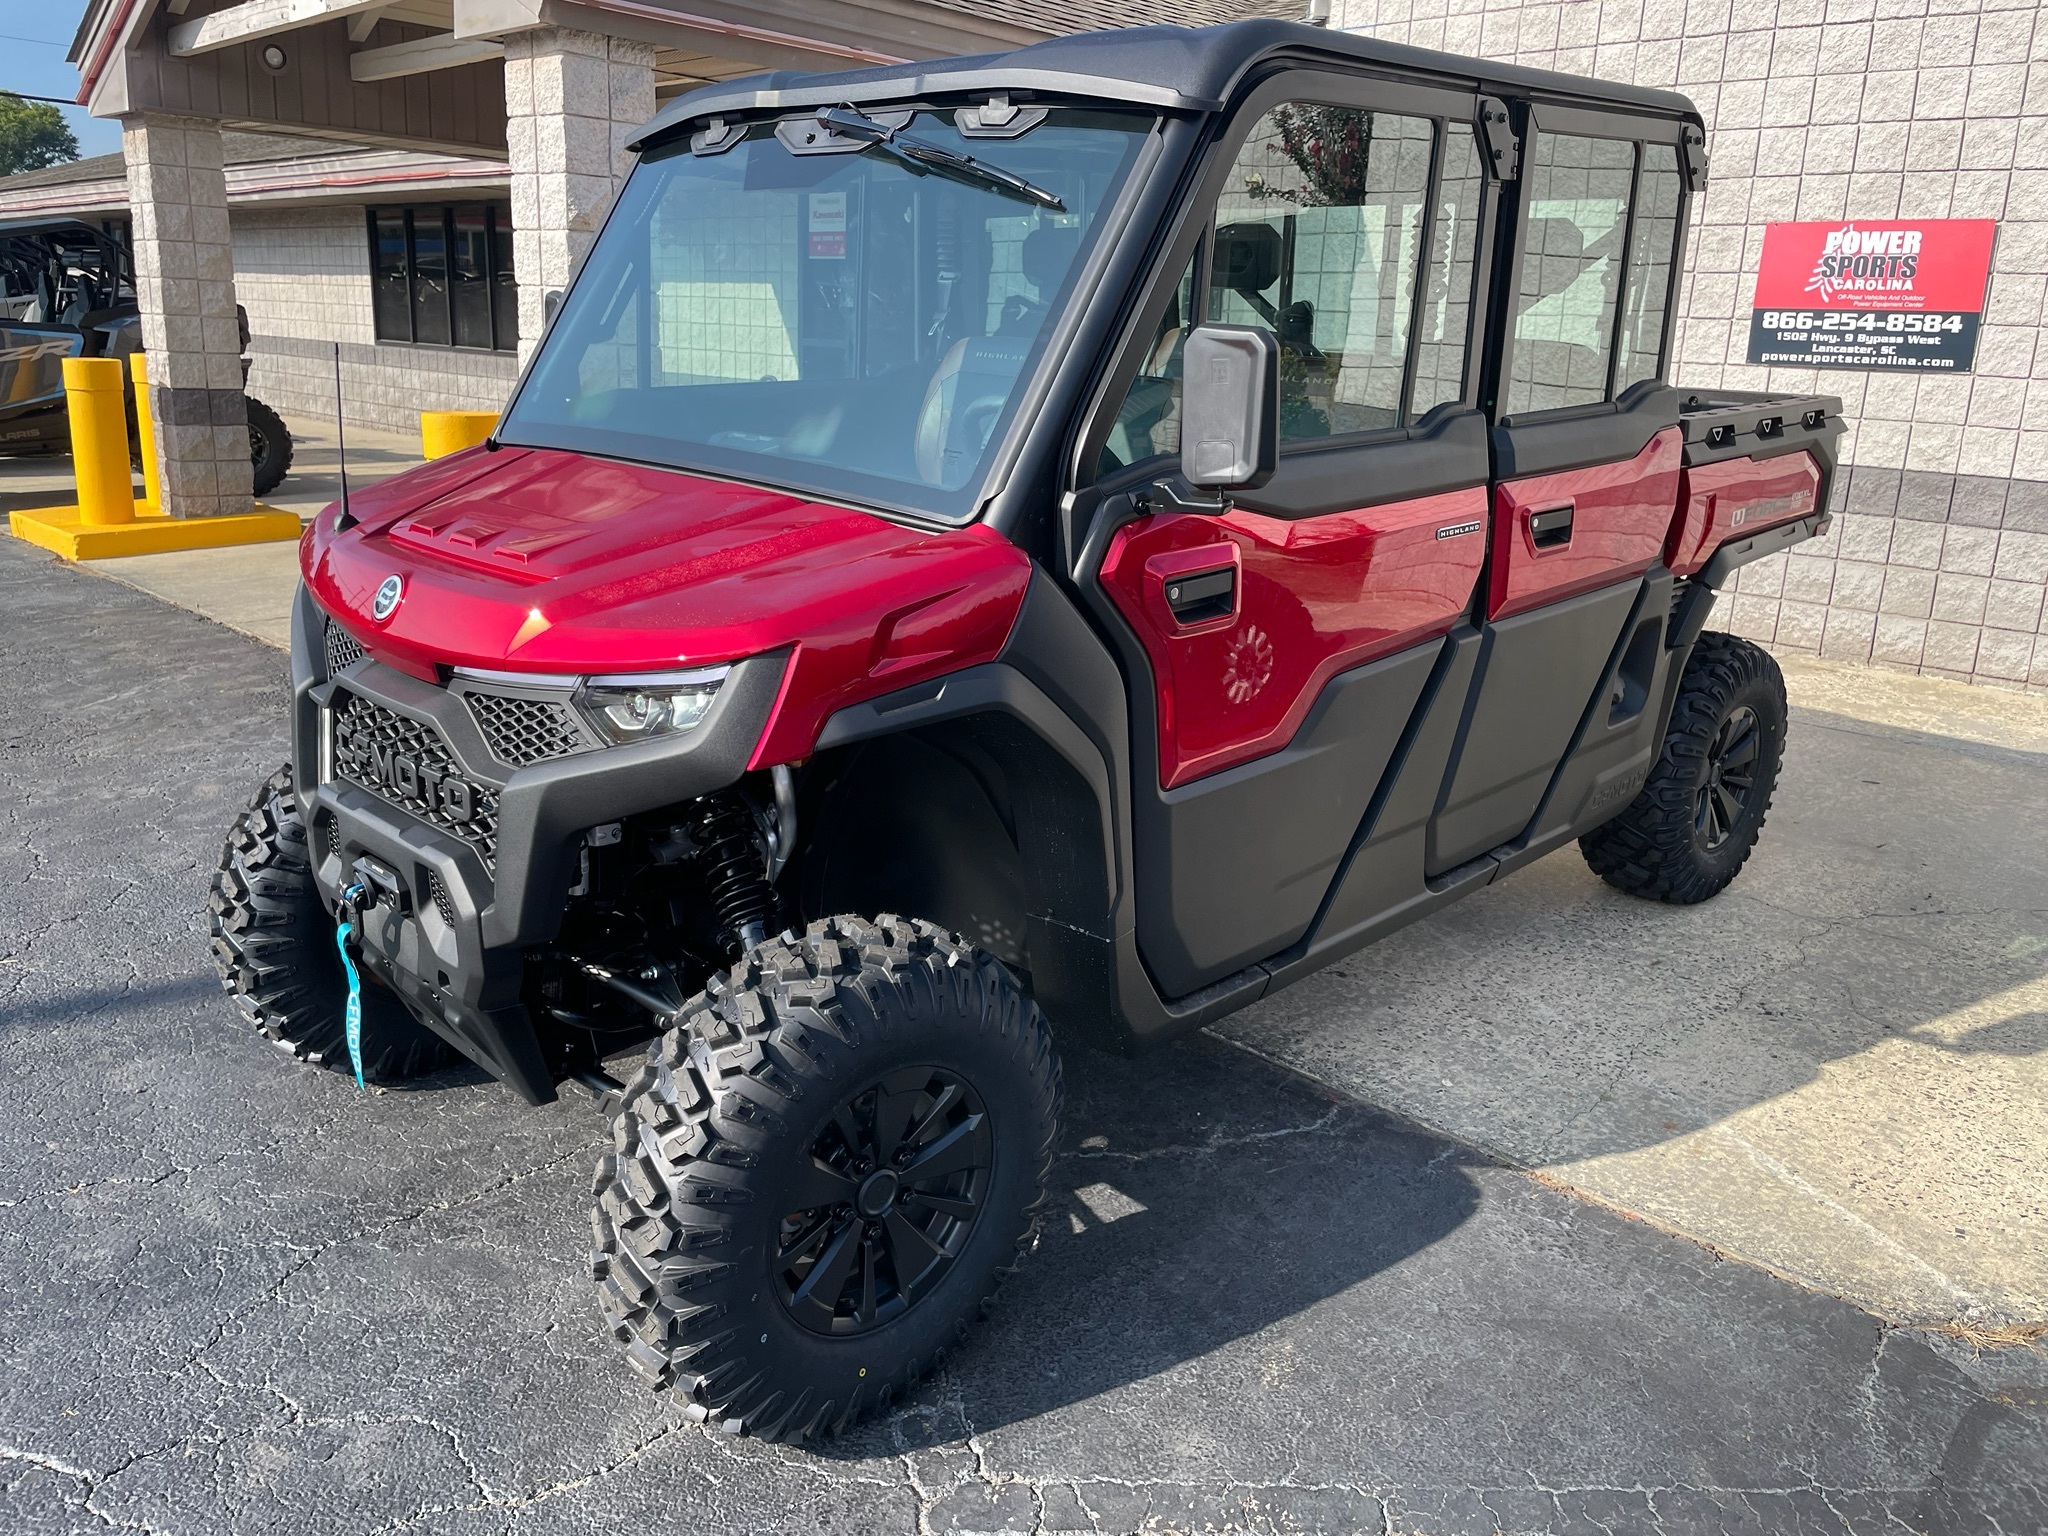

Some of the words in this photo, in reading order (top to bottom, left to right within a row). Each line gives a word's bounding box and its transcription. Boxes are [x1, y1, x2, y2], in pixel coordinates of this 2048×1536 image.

[1822, 231, 1922, 254] POWER
[1821, 255, 1918, 278] SPORTS
[1833, 279, 1914, 291] CAROLINA
[1837, 293, 1862, 301] Off-Road
[1864, 293, 1887, 301] Vehicles
[1762, 311, 1963, 334] 866-254-8584
[1776, 331, 1808, 341] 1502
[1811, 332, 1841, 344] Hwy.
[1844, 333, 1854, 343] 9
[1857, 333, 1904, 345] Bypass
[1907, 334, 1942, 345] West
[975, 351, 1026, 361] HIGHLAN
[1812, 343, 1877, 355] Lancaster,
[1880, 345, 1897, 355] SC
[1761, 352, 1955, 368] powersportscarolina.com
[1440, 524, 1480, 538] HIGHLAND
[336, 722, 472, 823] CFMOTO
